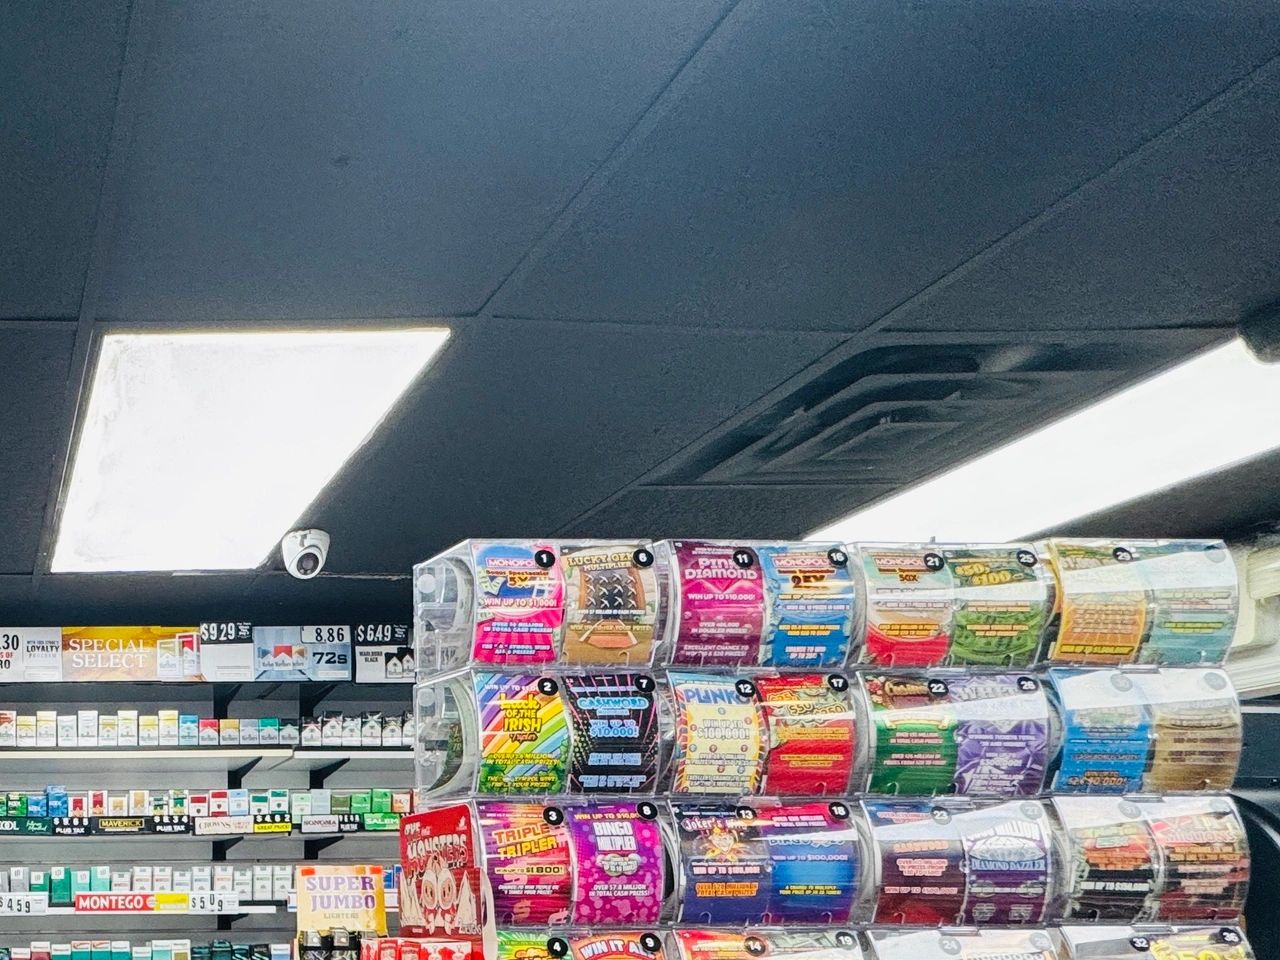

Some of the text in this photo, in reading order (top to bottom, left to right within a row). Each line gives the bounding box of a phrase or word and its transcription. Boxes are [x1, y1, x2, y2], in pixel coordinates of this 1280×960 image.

[541, 553, 547, 562] 1
[568, 554, 608, 565] LUCKY
[737, 554, 748, 563] 11
[830, 552, 843, 562] 16
[927, 557, 941, 566] 21
[1020, 554, 1034, 563] 25
[315, 627, 345, 642] 8.86
[26, 645, 59, 653] LOYALTY
[68, 639, 152, 652] SPECIAL
[72, 654, 148, 668] SELECT
[312, 652, 348, 665] 72s
[544, 682, 552, 692] 2
[639, 679, 648, 688] 7
[831, 678, 843, 687] 17
[738, 683, 752, 693] 12
[931, 684, 945, 692] 22
[507, 710, 536, 718] OF THE
[504, 718, 542, 732] IRISH
[549, 811, 557, 820] 3
[643, 806, 651, 815] 8
[740, 809, 752, 818] 13
[831, 806, 845, 815] 18
[366, 817, 399, 826] SALEM
[593, 822, 633, 835] BINGO
[495, 825, 550, 843] TRIPLE
[498, 836, 557, 859] TRIPLER
[597, 836, 637, 850] MULTIPLIER
[306, 875, 375, 891] SUPER
[78, 895, 143, 911] MONTEGO
[311, 895, 376, 912] JUMBO
[646, 937, 655, 946] 9
[748, 941, 761, 951] 14
[839, 937, 852, 945] 19
[553, 942, 561, 951] 4
[580, 939, 624, 960] WIN IT
